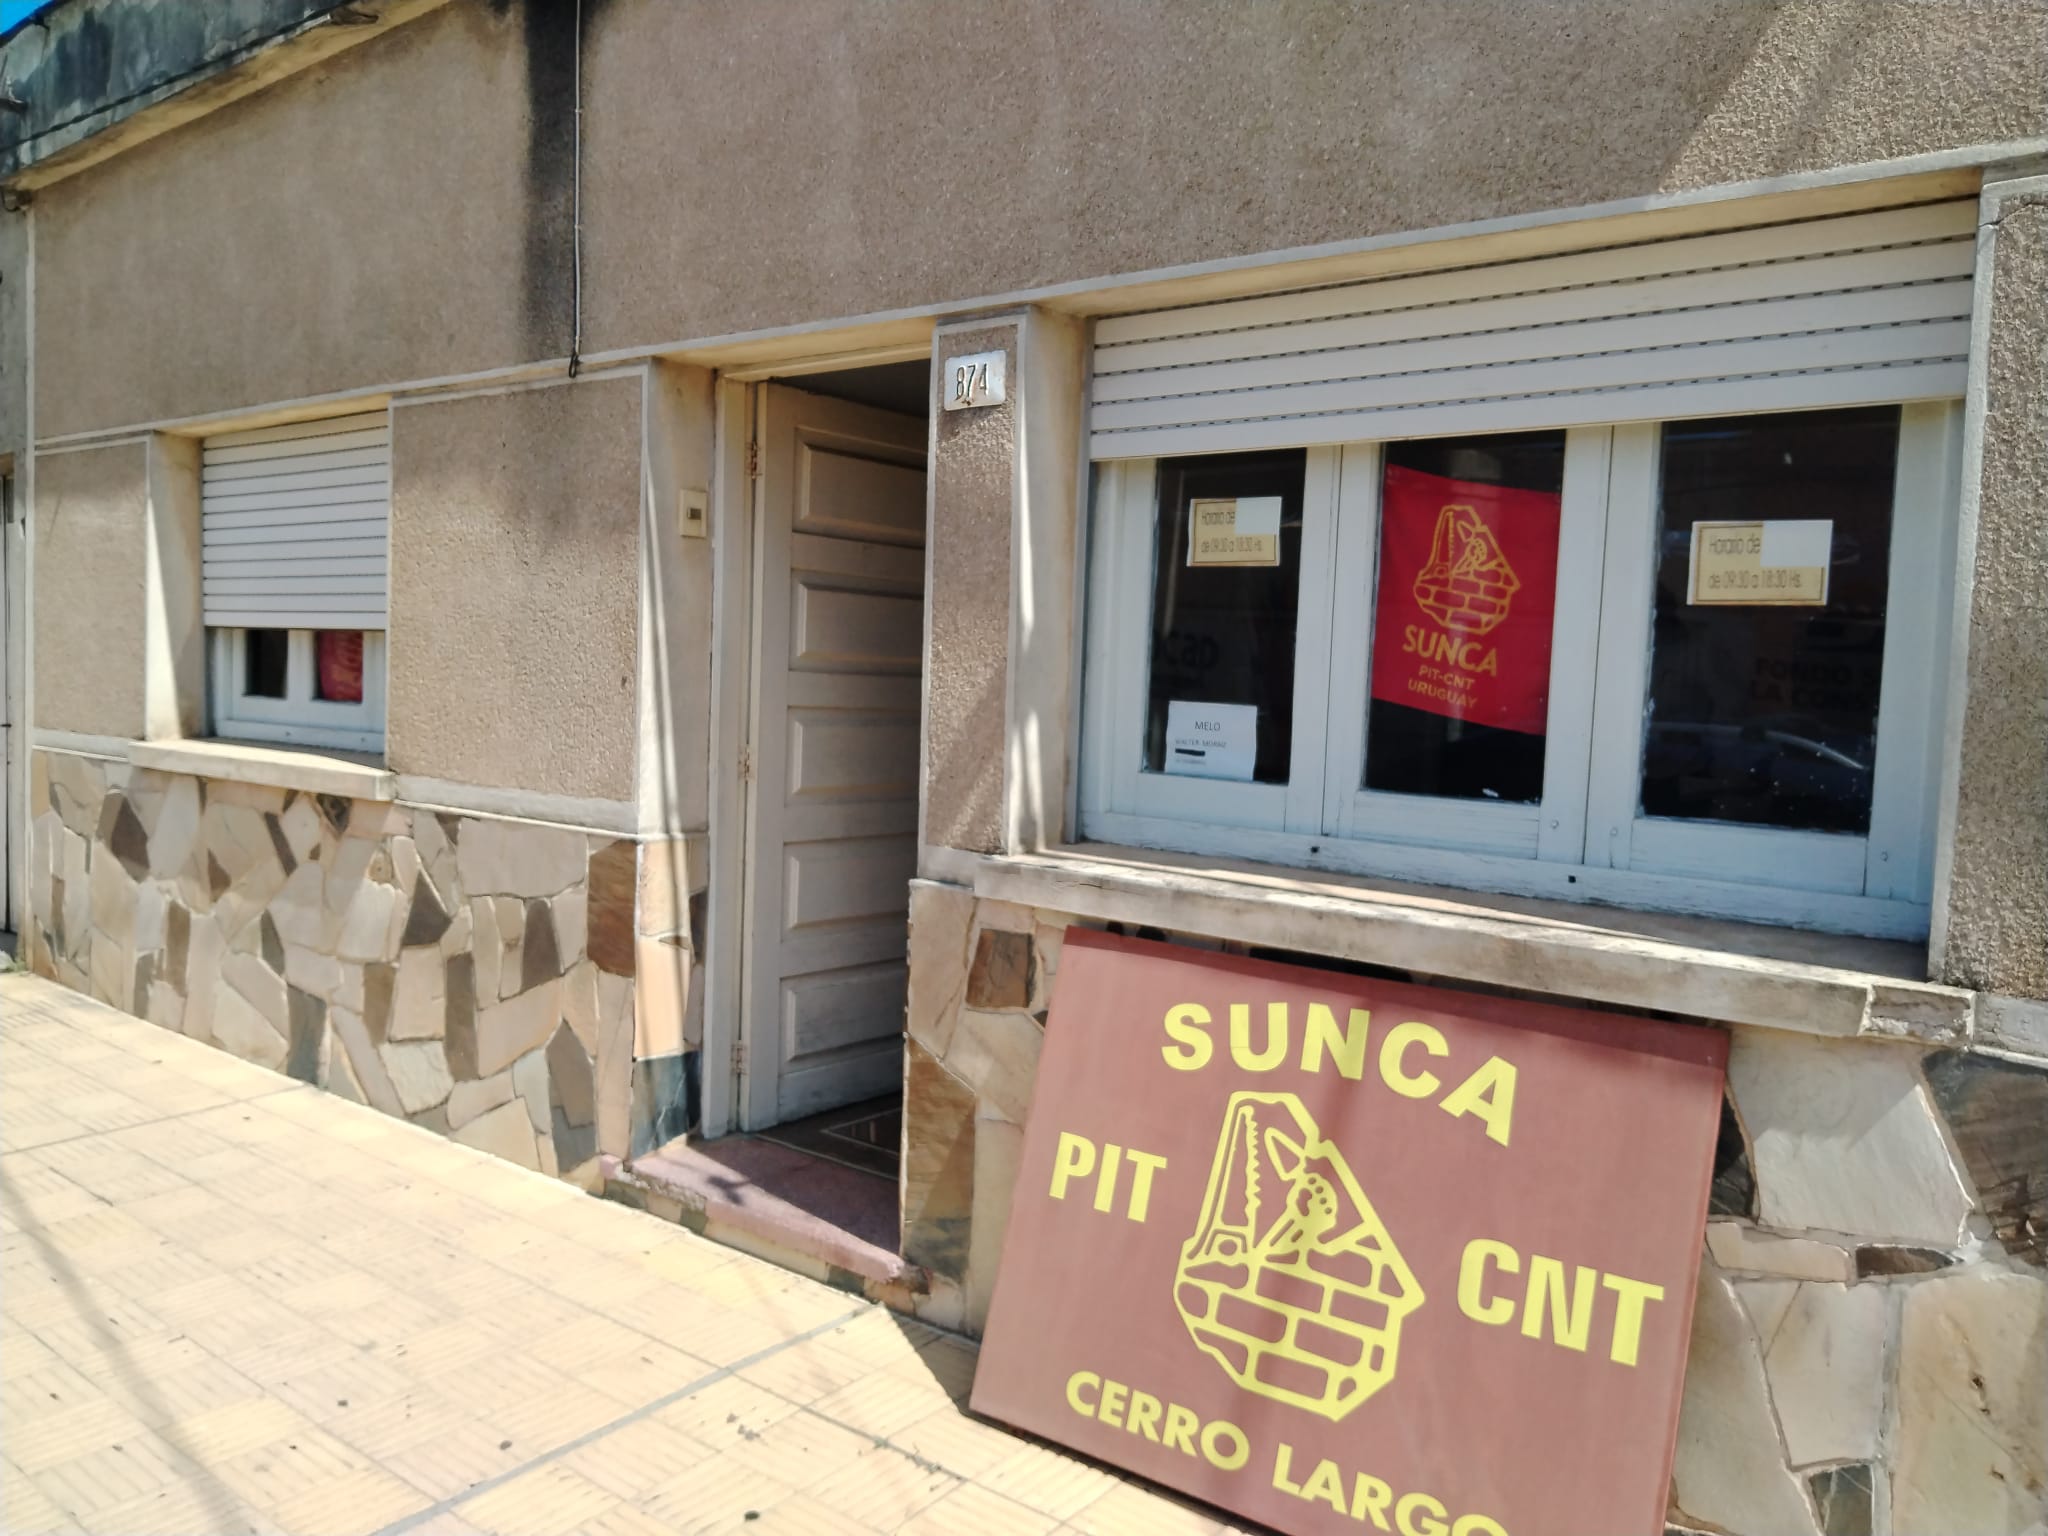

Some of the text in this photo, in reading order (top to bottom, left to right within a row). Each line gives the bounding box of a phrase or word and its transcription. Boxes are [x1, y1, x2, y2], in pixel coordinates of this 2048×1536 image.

[955, 363, 988, 400] 874
[1745, 532, 1761, 555] de
[1402, 624, 1497, 677] SUNCA
[1408, 677, 1478, 708] URUGUAY
[1419, 665, 1475, 691] PIT-CNT
[1195, 720, 1221, 732] MELO
[1161, 1002, 1518, 1147] SUNCA
[1048, 1131, 1168, 1223] PIT
[1457, 1238, 1665, 1368] CNT
[1065, 1370, 1250, 1471] CERRO
